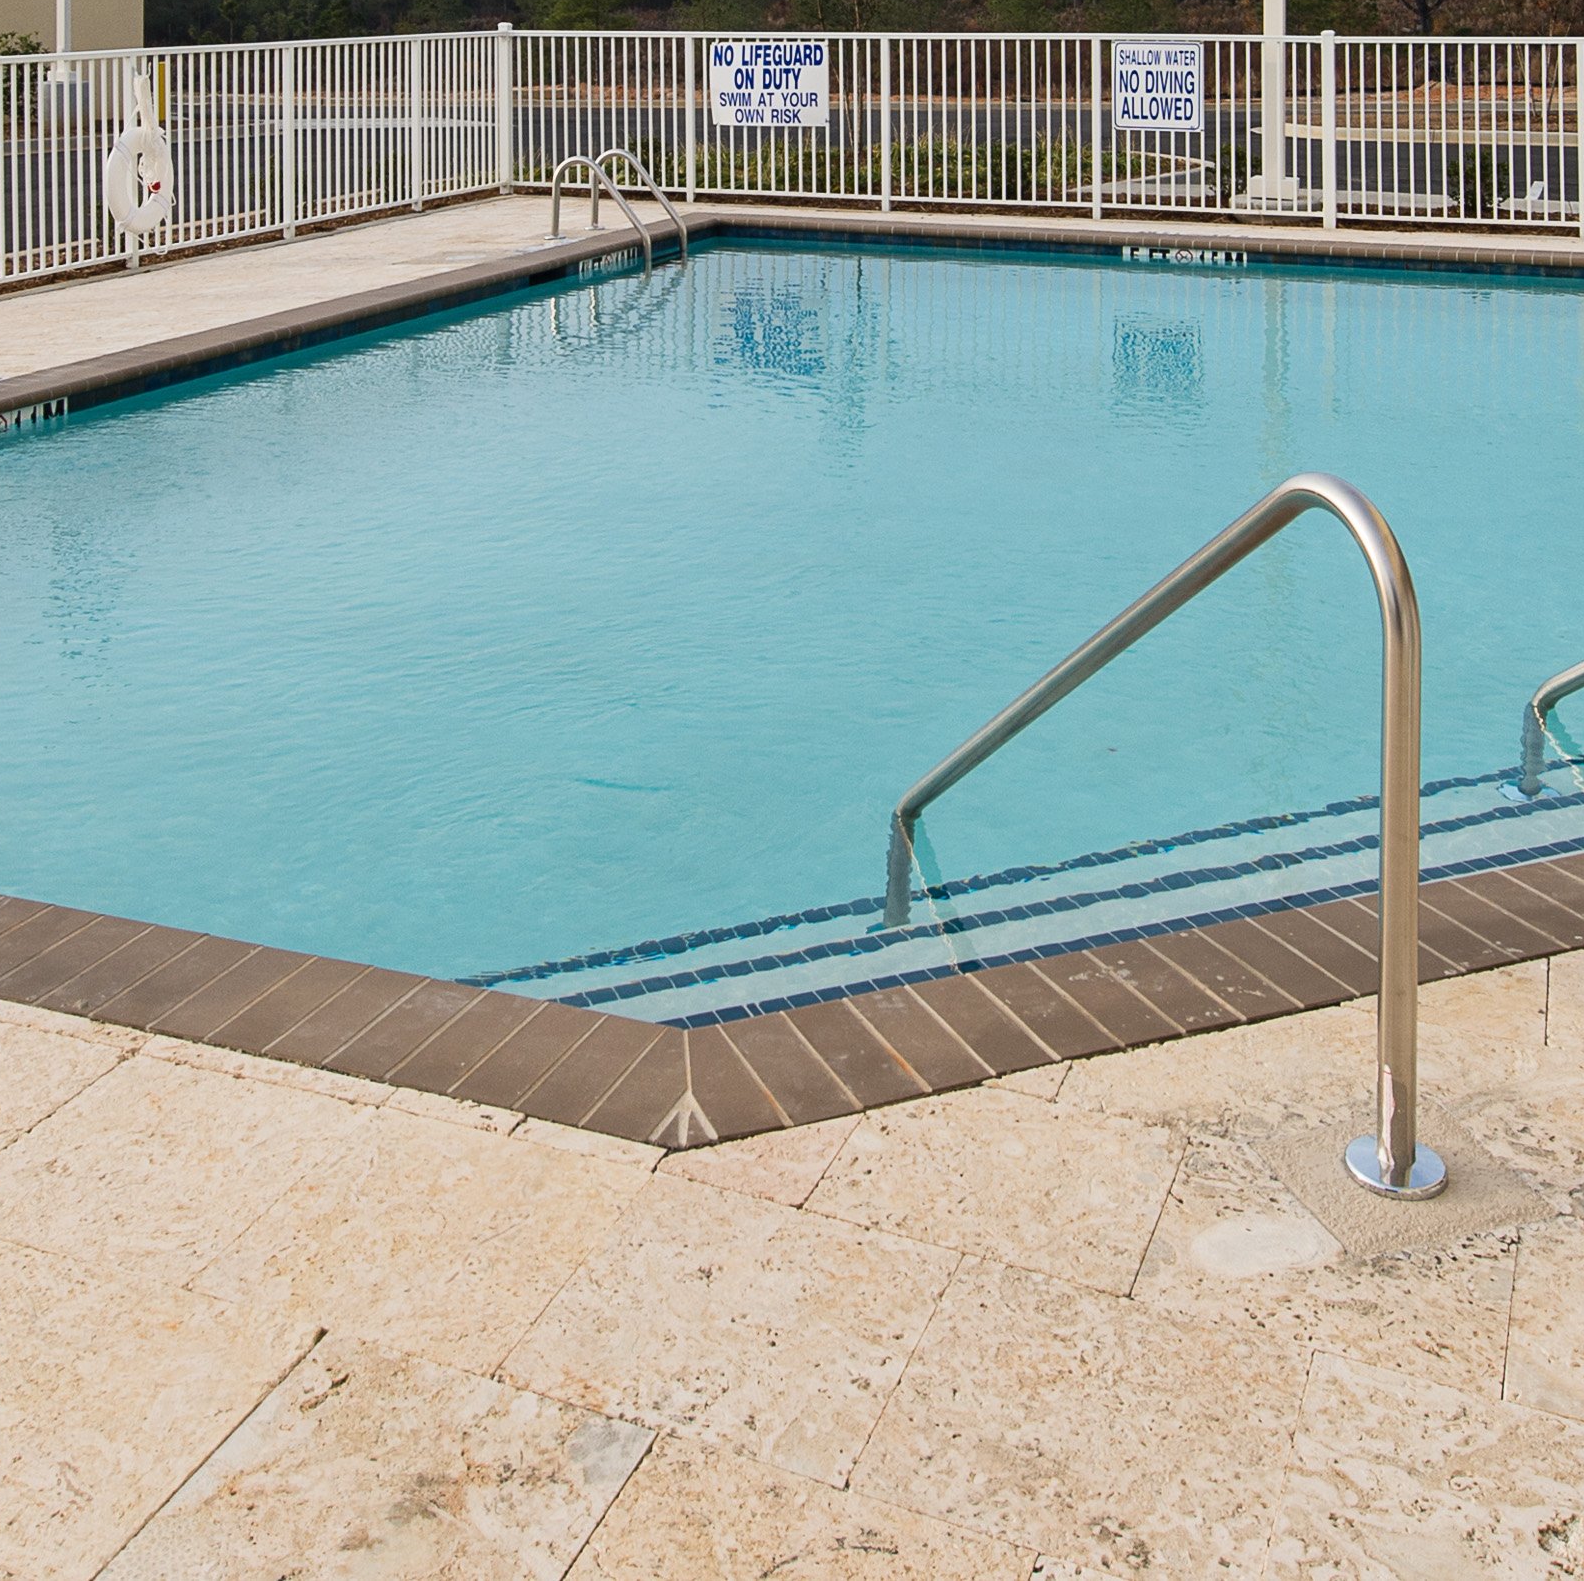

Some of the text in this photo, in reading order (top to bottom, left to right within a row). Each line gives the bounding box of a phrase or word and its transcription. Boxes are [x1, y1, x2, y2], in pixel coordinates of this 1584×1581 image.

[713, 44, 824, 67] NO LIFEGUARD
[1119, 49, 1196, 67] SHALLOW WATER
[734, 67, 801, 90] ON DUTY
[1119, 69, 1195, 95] NO DIVING
[719, 91, 818, 107] SWIM AT YOUR
[1121, 96, 1194, 121] ALLOWED
[735, 108, 802, 123] OWN RISK
